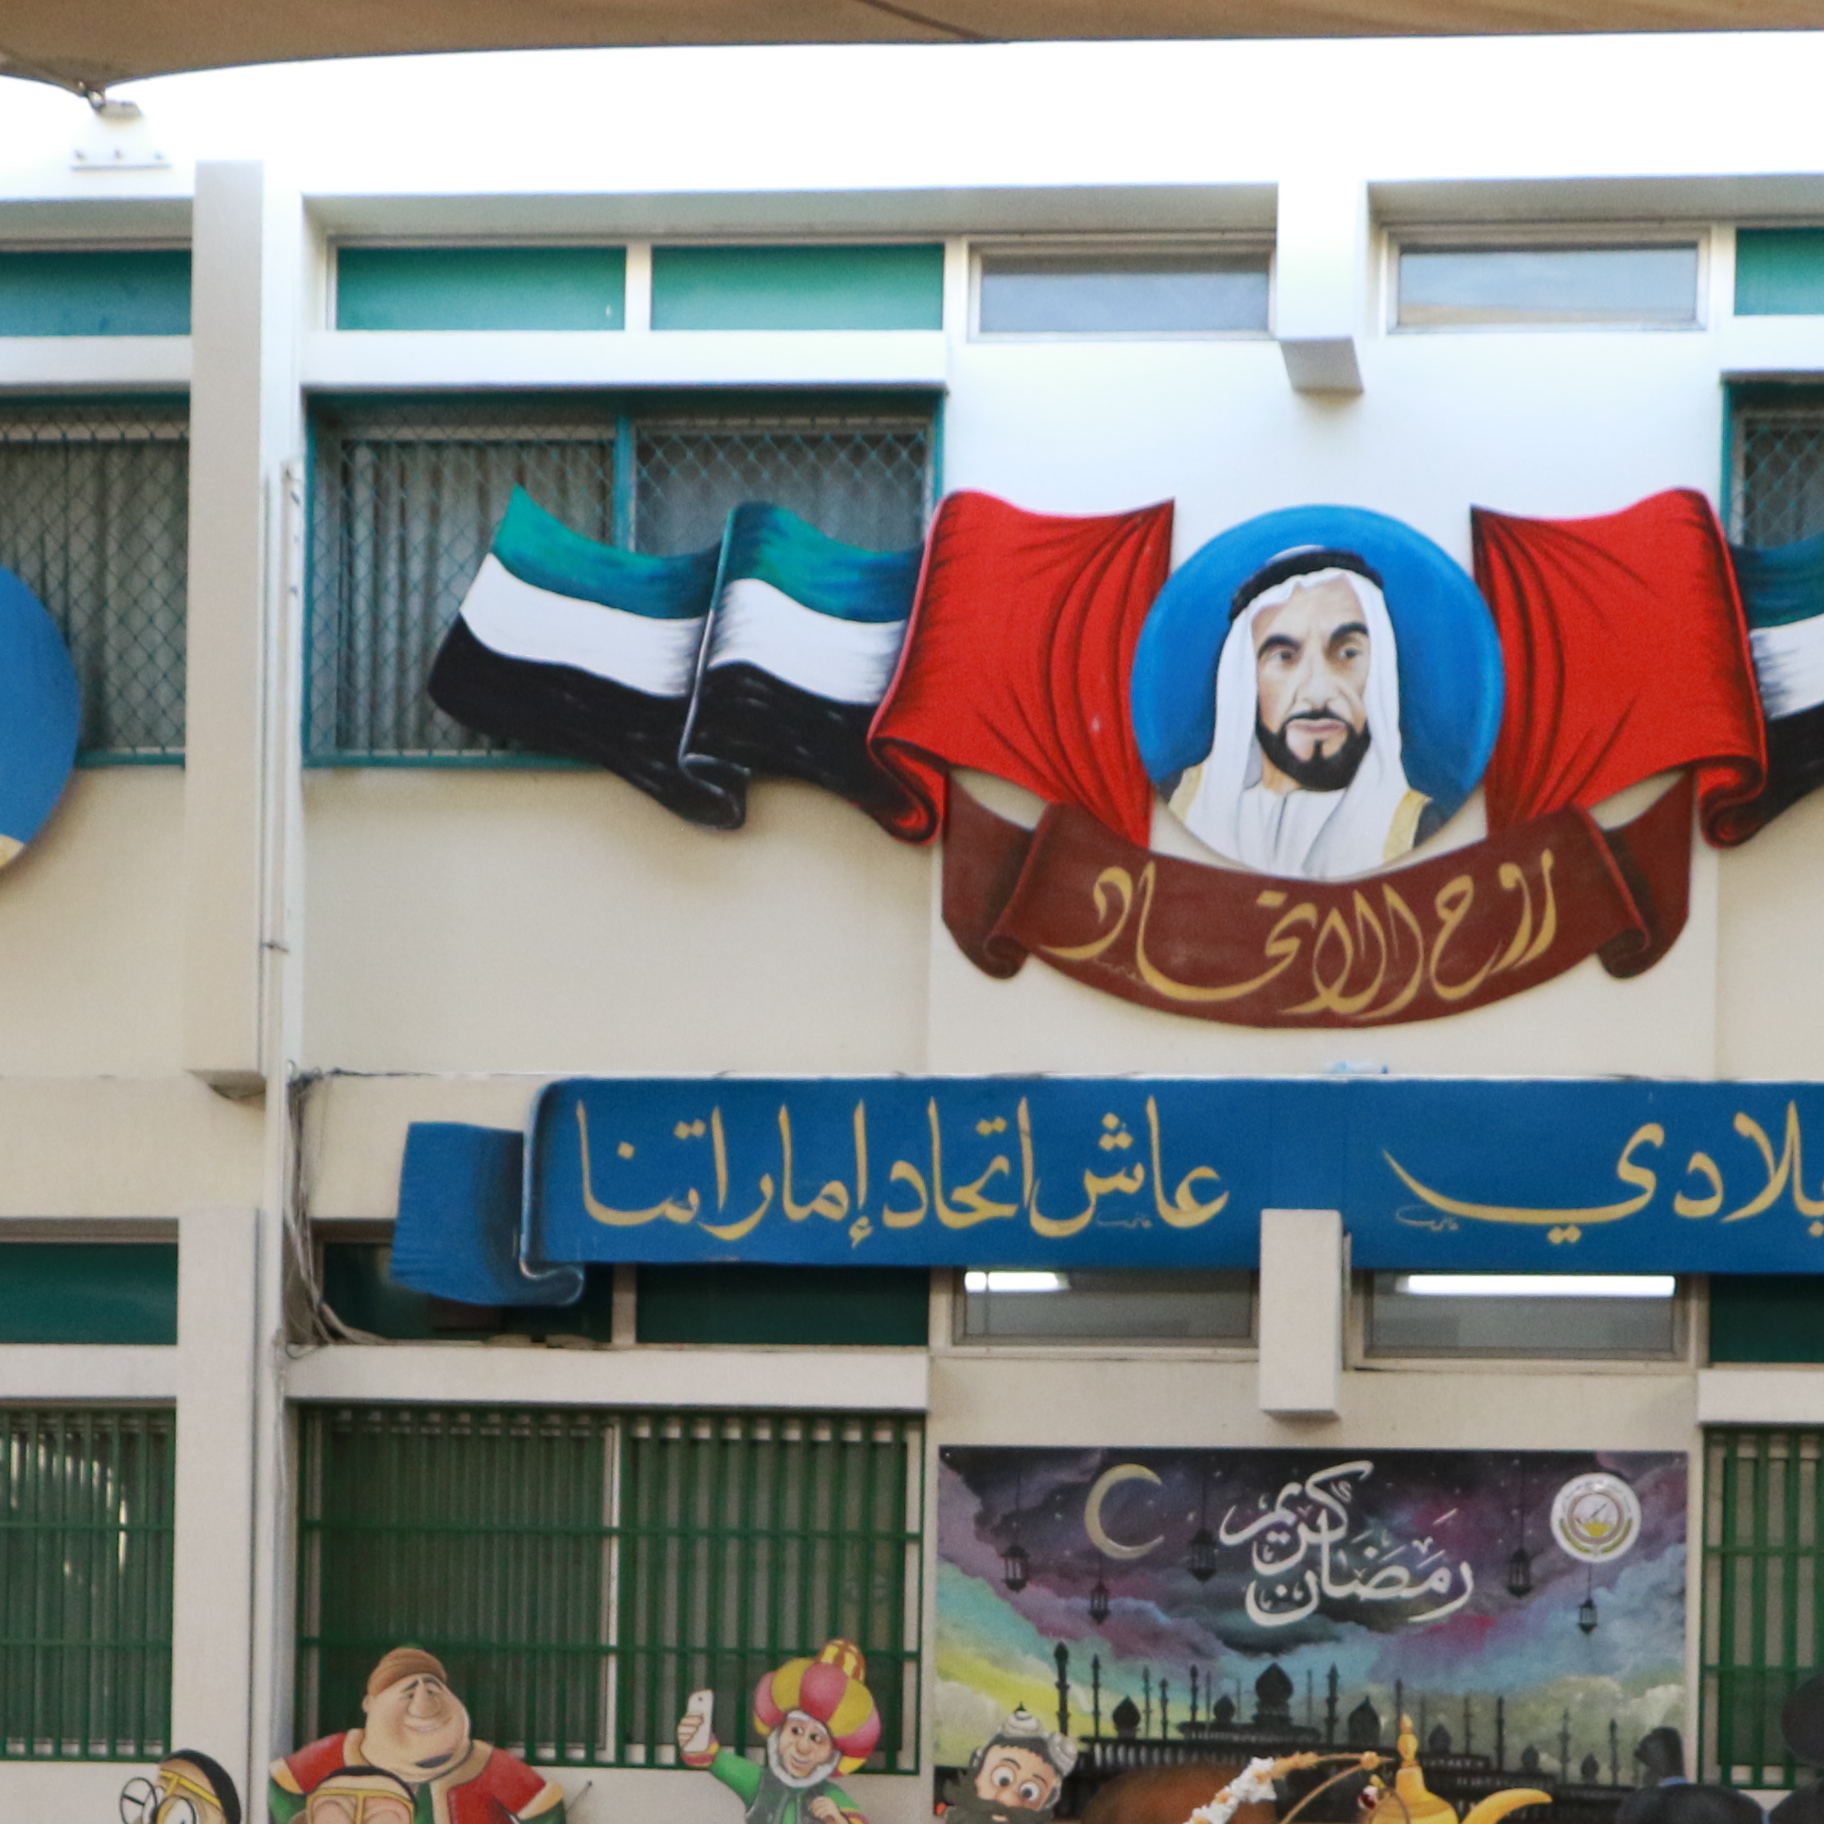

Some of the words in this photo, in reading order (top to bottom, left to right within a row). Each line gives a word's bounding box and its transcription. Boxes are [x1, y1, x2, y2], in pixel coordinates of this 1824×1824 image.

[1040, 860, 1424, 1020] الاتحاد
[1429, 848, 1557, 1001] روح
[576, 1099, 874, 1249] إماراتنا
[881, 1096, 1034, 1230] اتحاد
[1028, 1095, 1230, 1238] عاش
[1219, 1460, 1374, 1577] كريم
[1245, 1508, 1475, 1628] رمضان
